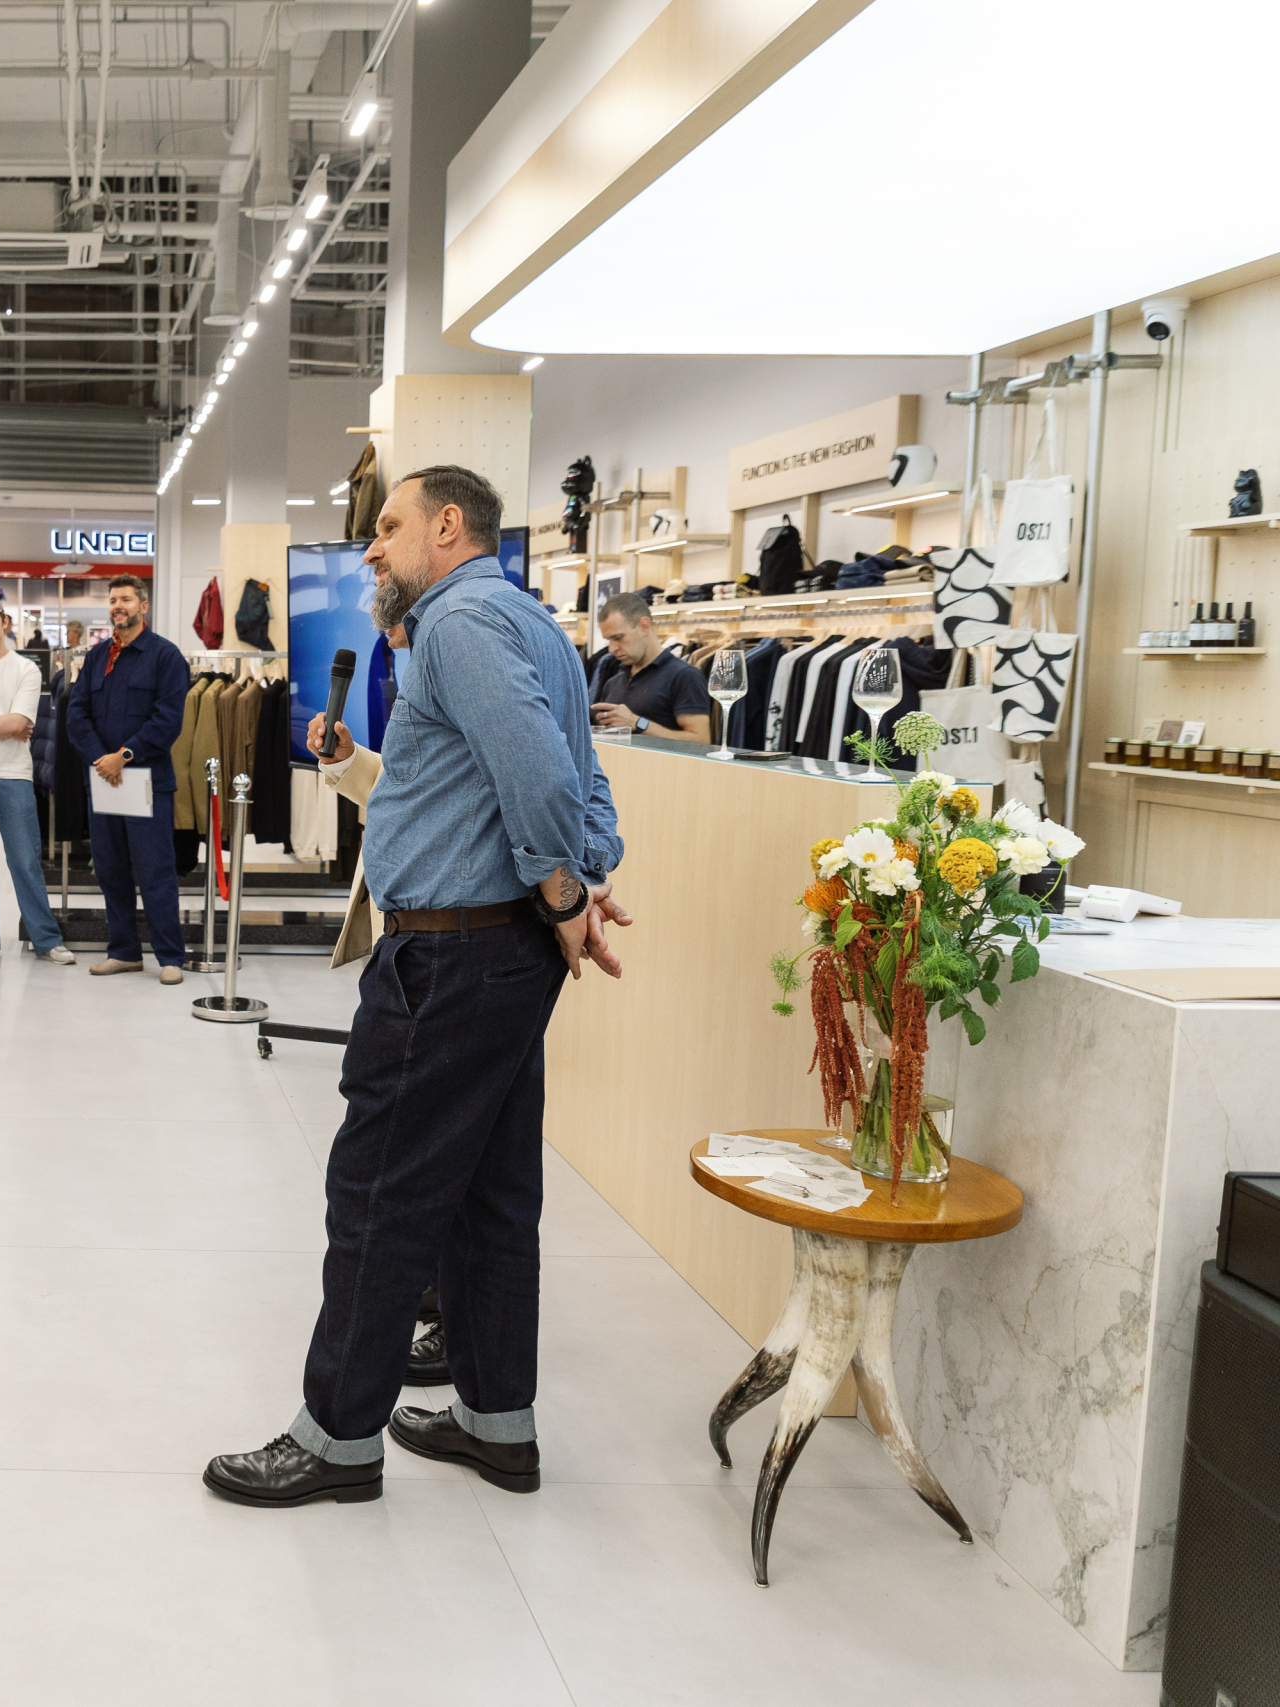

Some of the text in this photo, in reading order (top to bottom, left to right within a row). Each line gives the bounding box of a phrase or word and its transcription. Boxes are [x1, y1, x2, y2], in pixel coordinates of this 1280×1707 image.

[741, 460, 780, 482] FUNCTION
[791, 452, 807, 469] THE
[808, 446, 831, 465] NEW
[831, 433, 876, 458] FASHION
[1017, 521, 1051, 541] OST.1
[941, 726, 978, 745] OST.1
